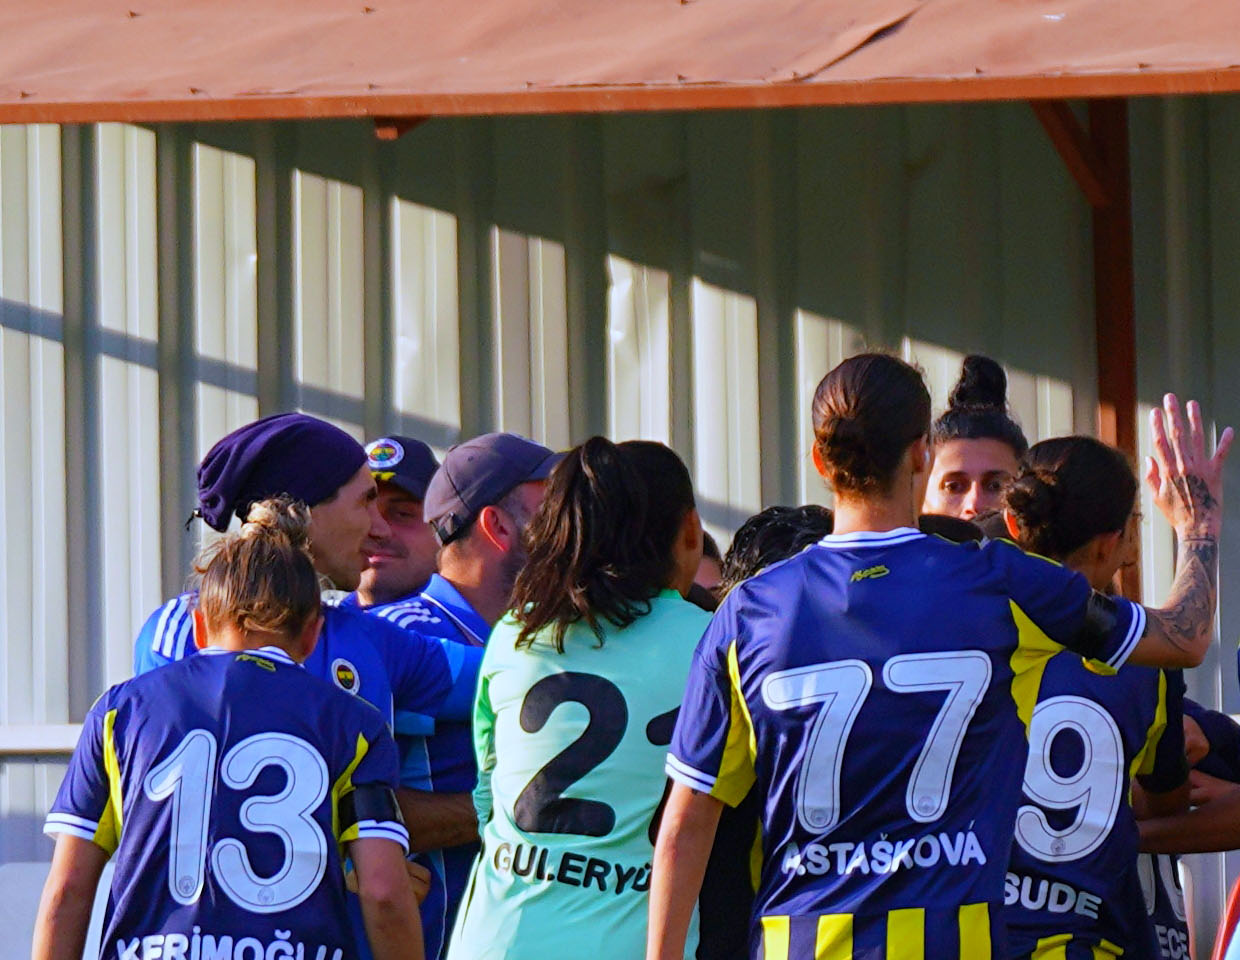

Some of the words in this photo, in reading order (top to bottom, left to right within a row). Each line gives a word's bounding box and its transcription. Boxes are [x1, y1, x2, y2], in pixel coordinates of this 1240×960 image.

[144, 729, 329, 913] 13
[514, 671, 684, 848] 2
[762, 650, 993, 834] 77
[1014, 695, 1125, 863] 9
[1004, 872, 1102, 920] SUDE
